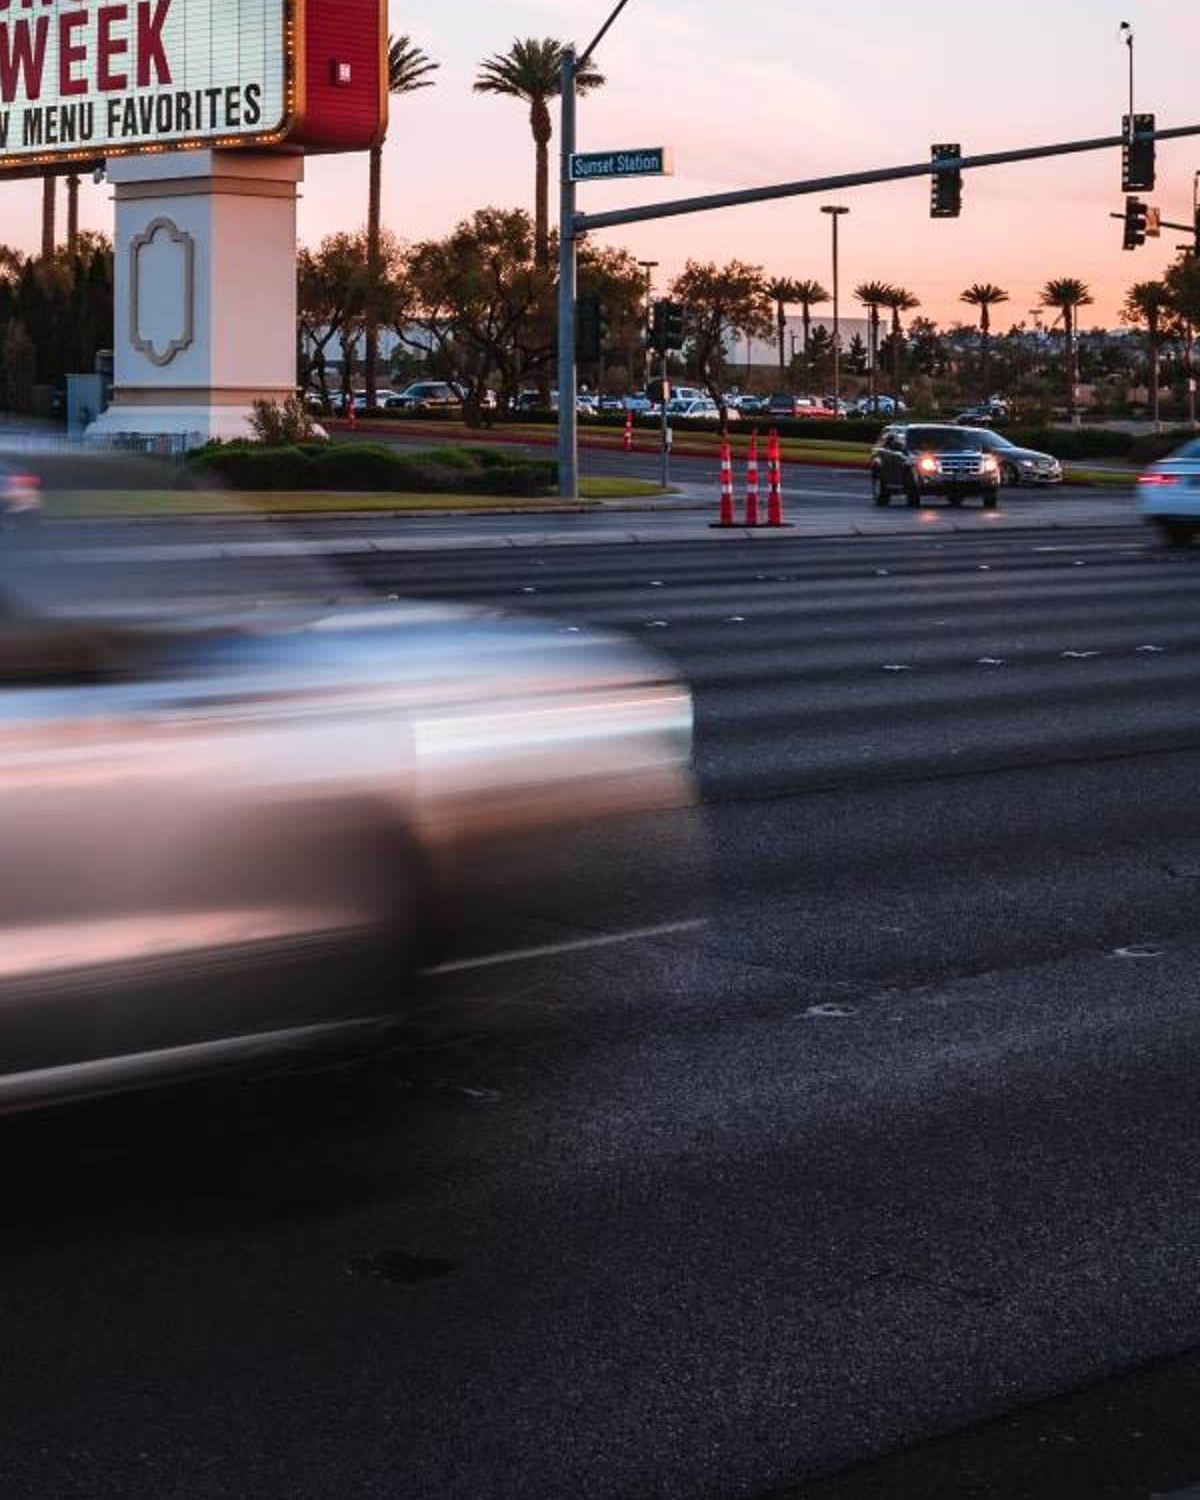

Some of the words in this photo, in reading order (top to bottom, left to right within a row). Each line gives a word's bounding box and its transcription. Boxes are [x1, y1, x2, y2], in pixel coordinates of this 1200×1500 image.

[23, 101, 94, 146] MENU
[107, 83, 262, 138] FAVORITES
[575, 157, 614, 175] Sunset
[617, 153, 659, 172] Station
